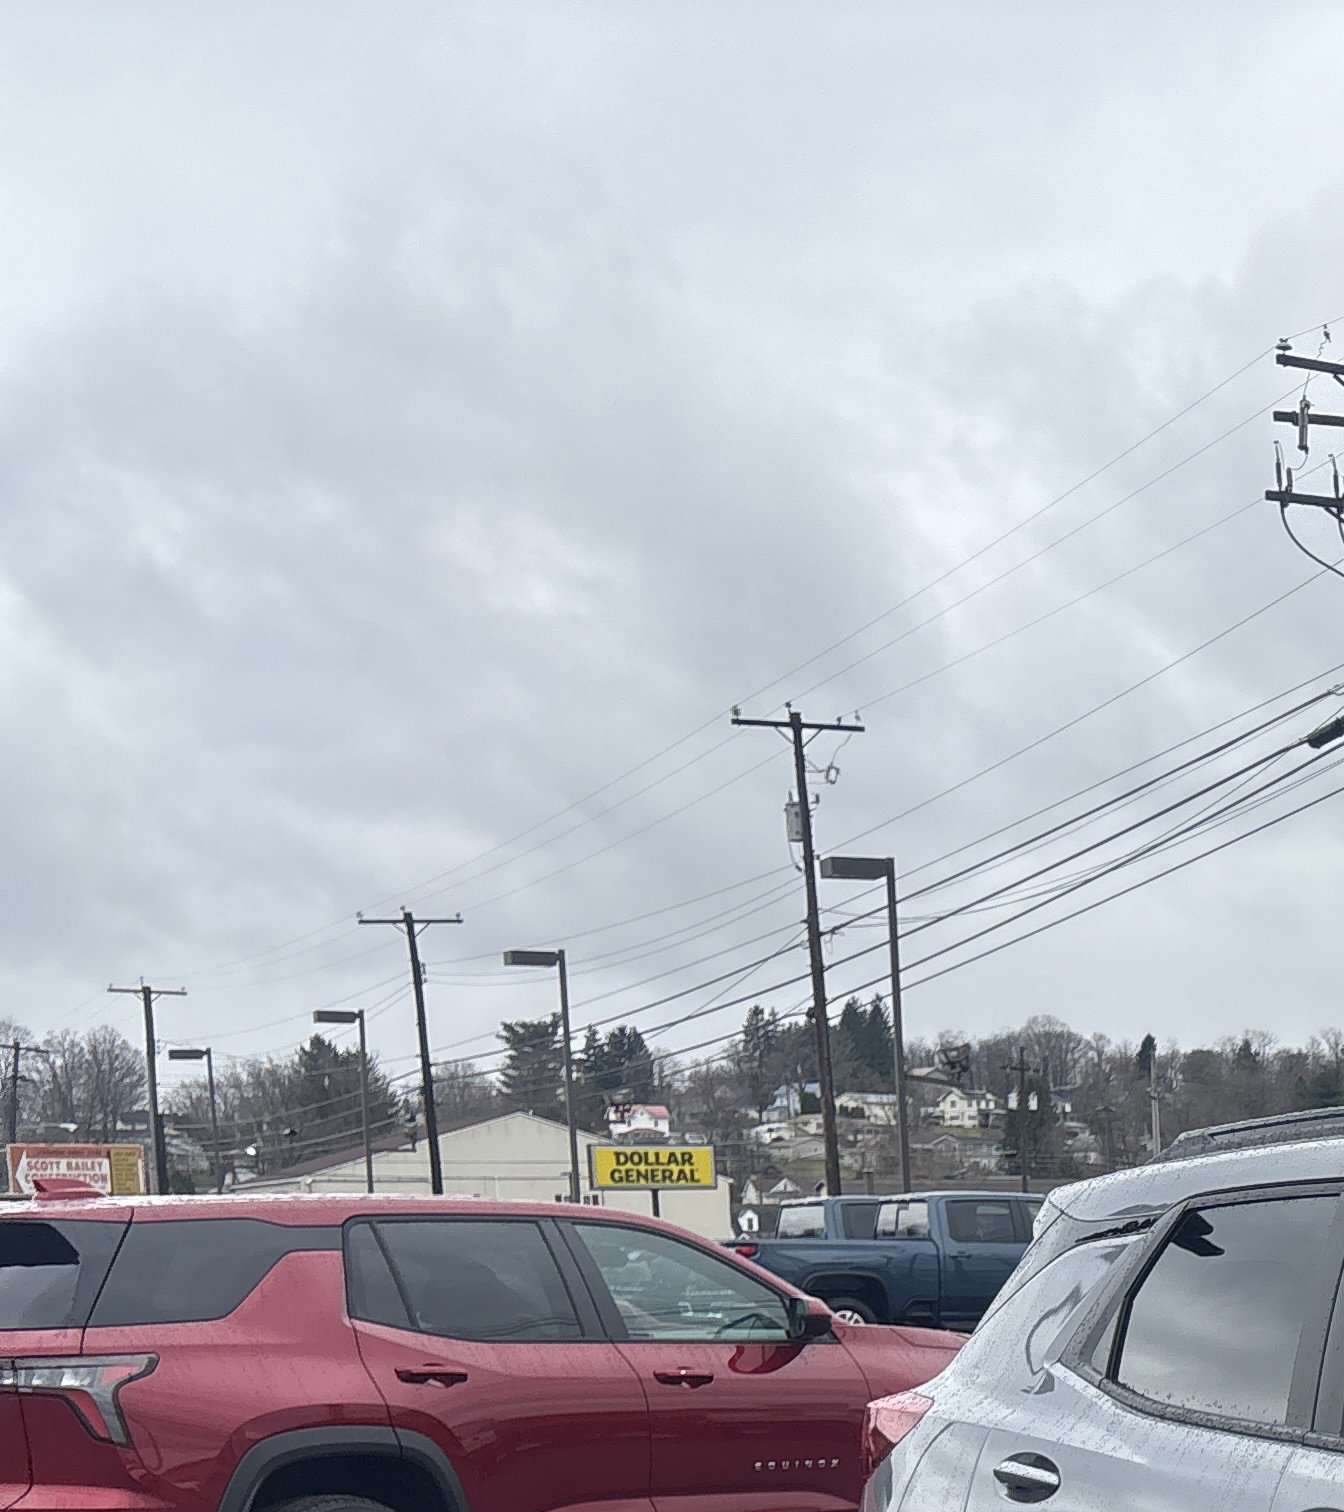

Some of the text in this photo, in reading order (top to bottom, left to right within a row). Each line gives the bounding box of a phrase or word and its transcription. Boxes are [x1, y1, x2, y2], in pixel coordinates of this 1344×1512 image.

[614, 1151, 694, 1166] DOLLAR
[26, 1160, 103, 1171] SCOTT BAILEY
[610, 1168, 700, 1183] GENERAL
[754, 1459, 839, 1471] EQUINOX
